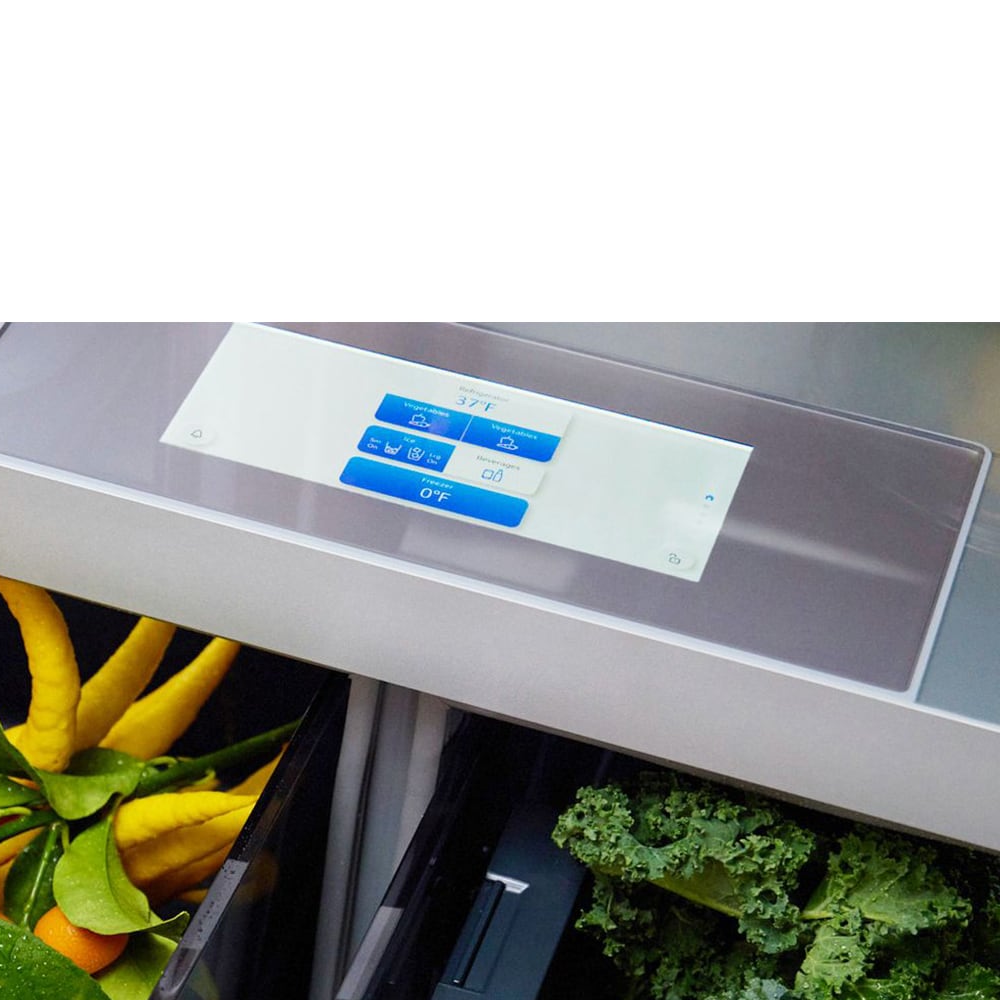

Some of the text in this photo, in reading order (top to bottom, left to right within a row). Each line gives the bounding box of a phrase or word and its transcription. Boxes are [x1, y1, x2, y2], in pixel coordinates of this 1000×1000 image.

[403, 401, 450, 418] Vegetables
[491, 423, 538, 440] Vegetables
[476, 455, 521, 470] Beverages
[421, 477, 453, 489] Freezer
